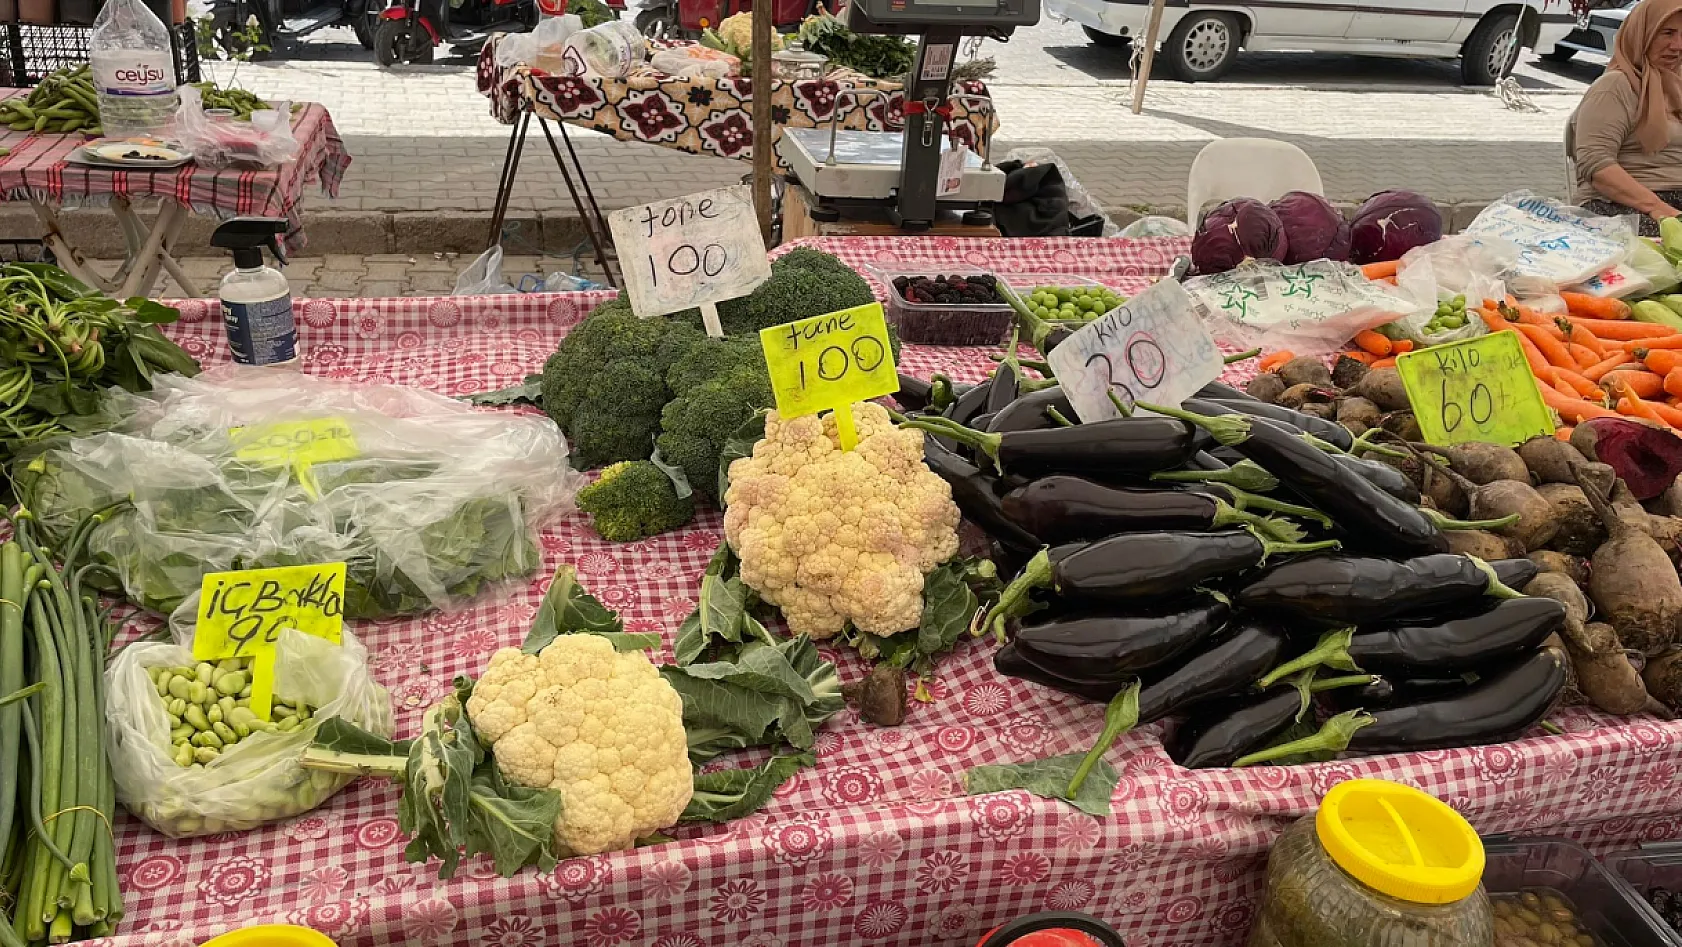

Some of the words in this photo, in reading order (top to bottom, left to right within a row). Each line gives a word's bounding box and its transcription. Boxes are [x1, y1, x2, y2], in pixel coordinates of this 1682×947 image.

[649, 243, 727, 288] 100
[799, 335, 885, 390] 100
[1085, 339, 1166, 416] 30
[1441, 377, 1492, 433] 60
